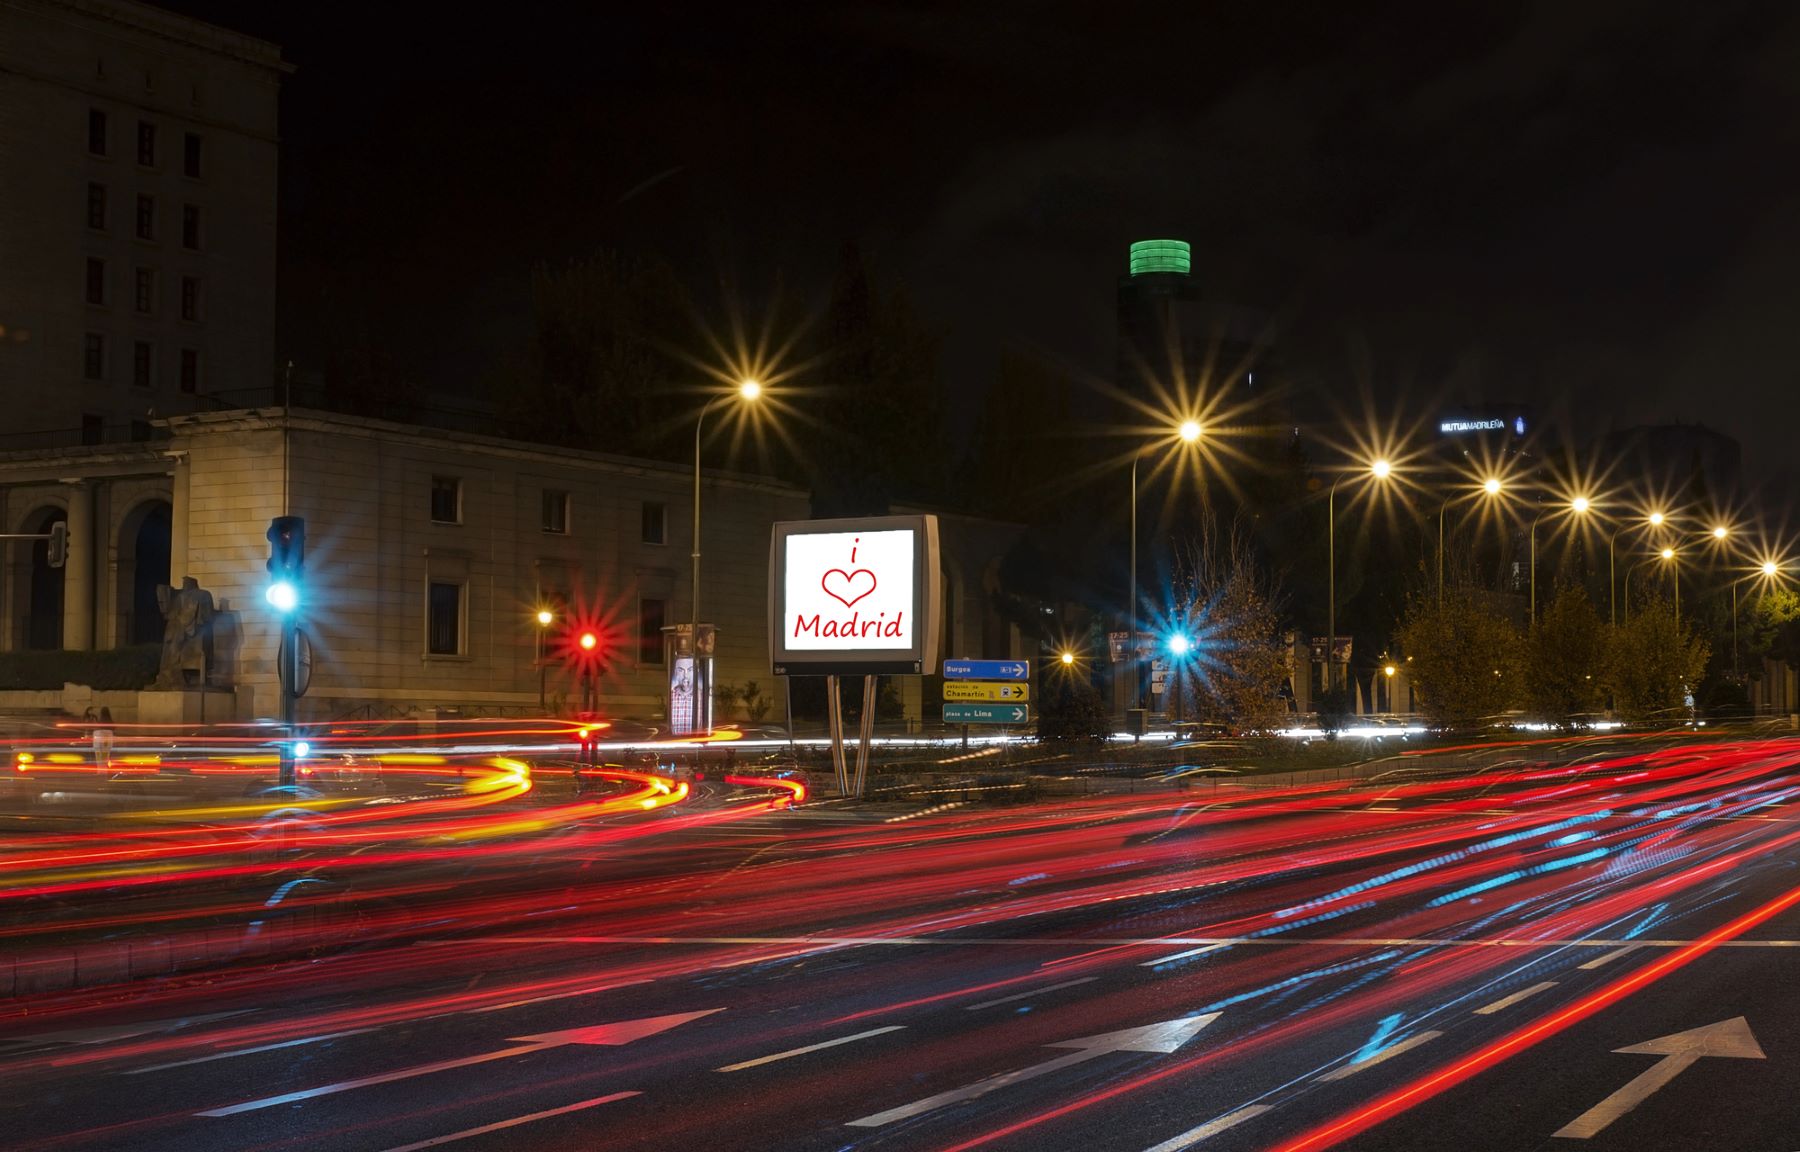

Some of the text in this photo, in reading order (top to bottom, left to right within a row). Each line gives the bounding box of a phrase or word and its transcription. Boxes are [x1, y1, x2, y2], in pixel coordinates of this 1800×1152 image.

[850, 537, 860, 564] i
[794, 611, 903, 638] Madrid
[946, 666, 971, 674] Burgos
